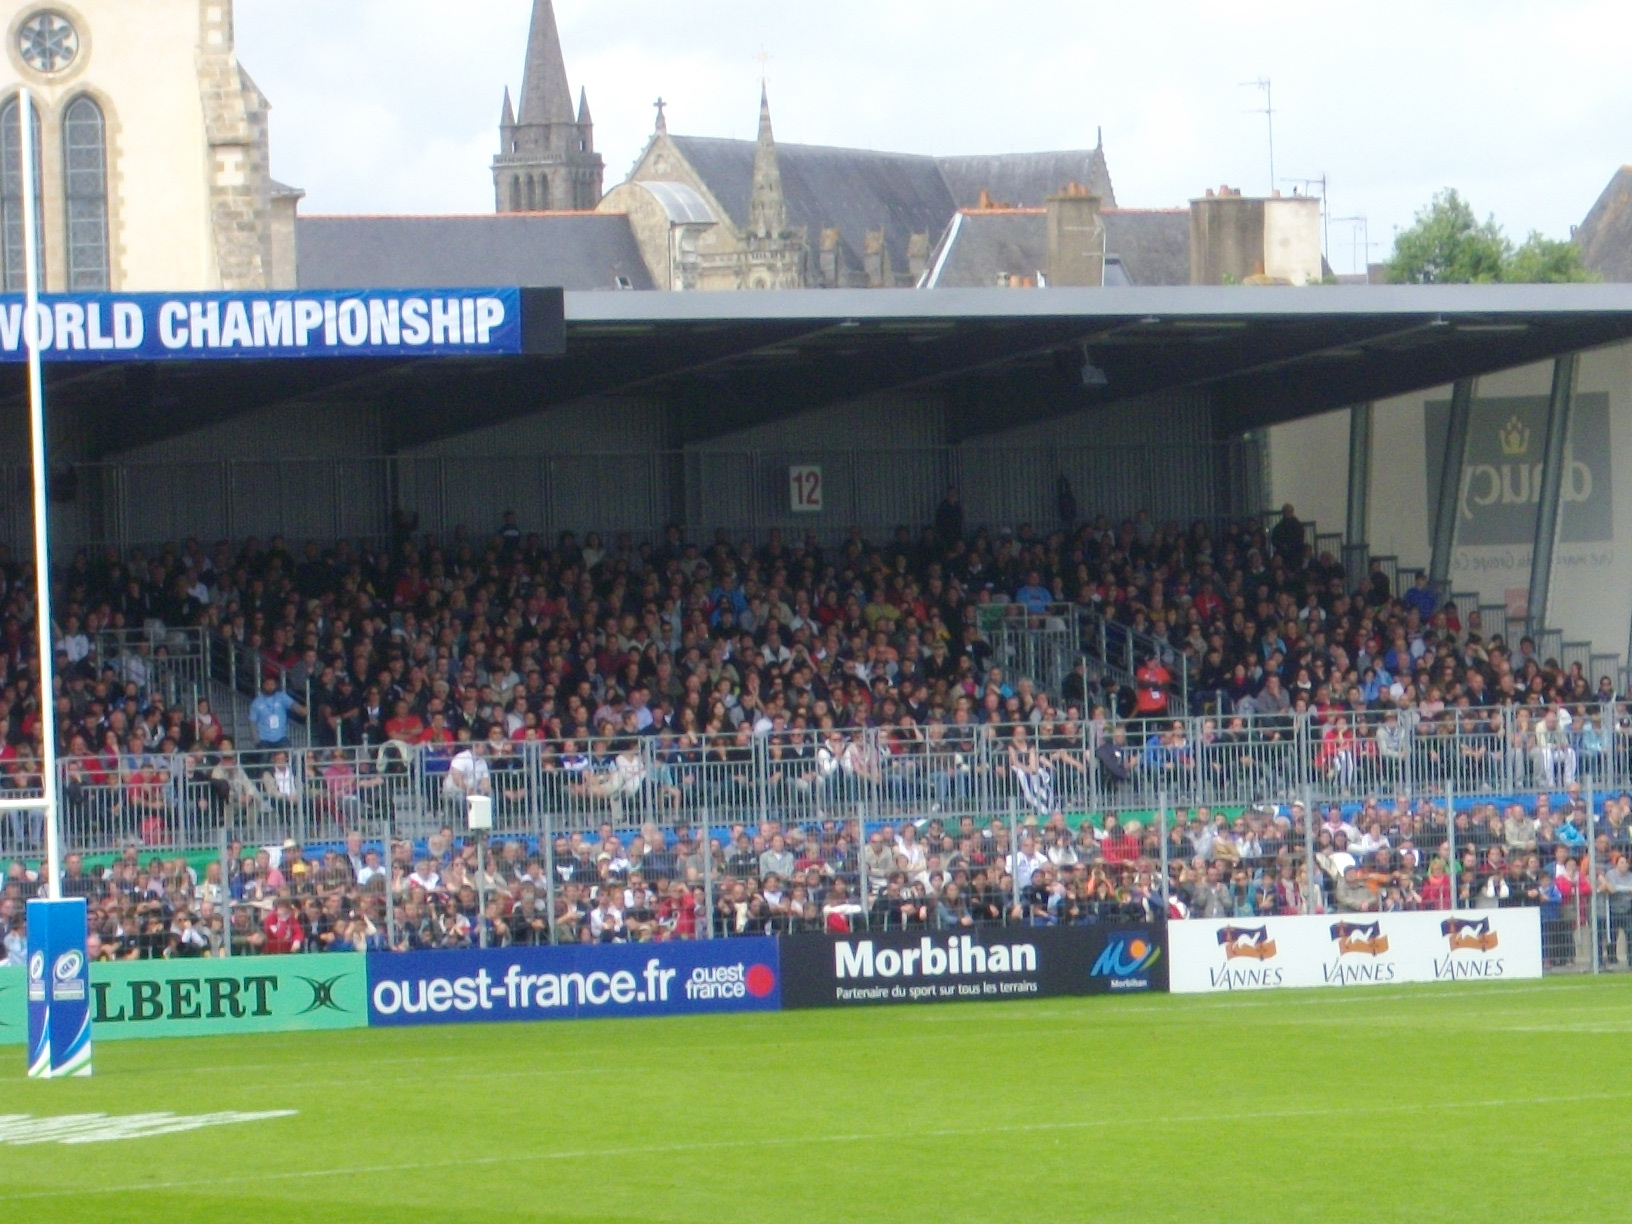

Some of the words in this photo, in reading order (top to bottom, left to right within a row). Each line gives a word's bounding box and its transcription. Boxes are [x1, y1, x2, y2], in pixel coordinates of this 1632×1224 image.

[158, 297, 505, 350] CHAMPIONSHIP
[791, 470, 820, 506] 12
[691, 961, 745, 983] ouest
[834, 935, 1038, 979] Morbihan
[1322, 956, 1396, 986] VANNES
[1433, 953, 1505, 981] VANNES
[373, 957, 677, 1015] ouest-france.fr
[684, 979, 746, 1001] france
[836, 986, 889, 1000] Partenaire
[891, 984, 906, 998] du
[909, 984, 938, 999] sport
[939, 986, 957, 997] sur
[958, 984, 981, 996] tous
[983, 981, 998, 995] les
[999, 980, 1038, 995] terrains
[1209, 962, 1284, 991] VANNES
[91, 975, 278, 1023] LBERT
